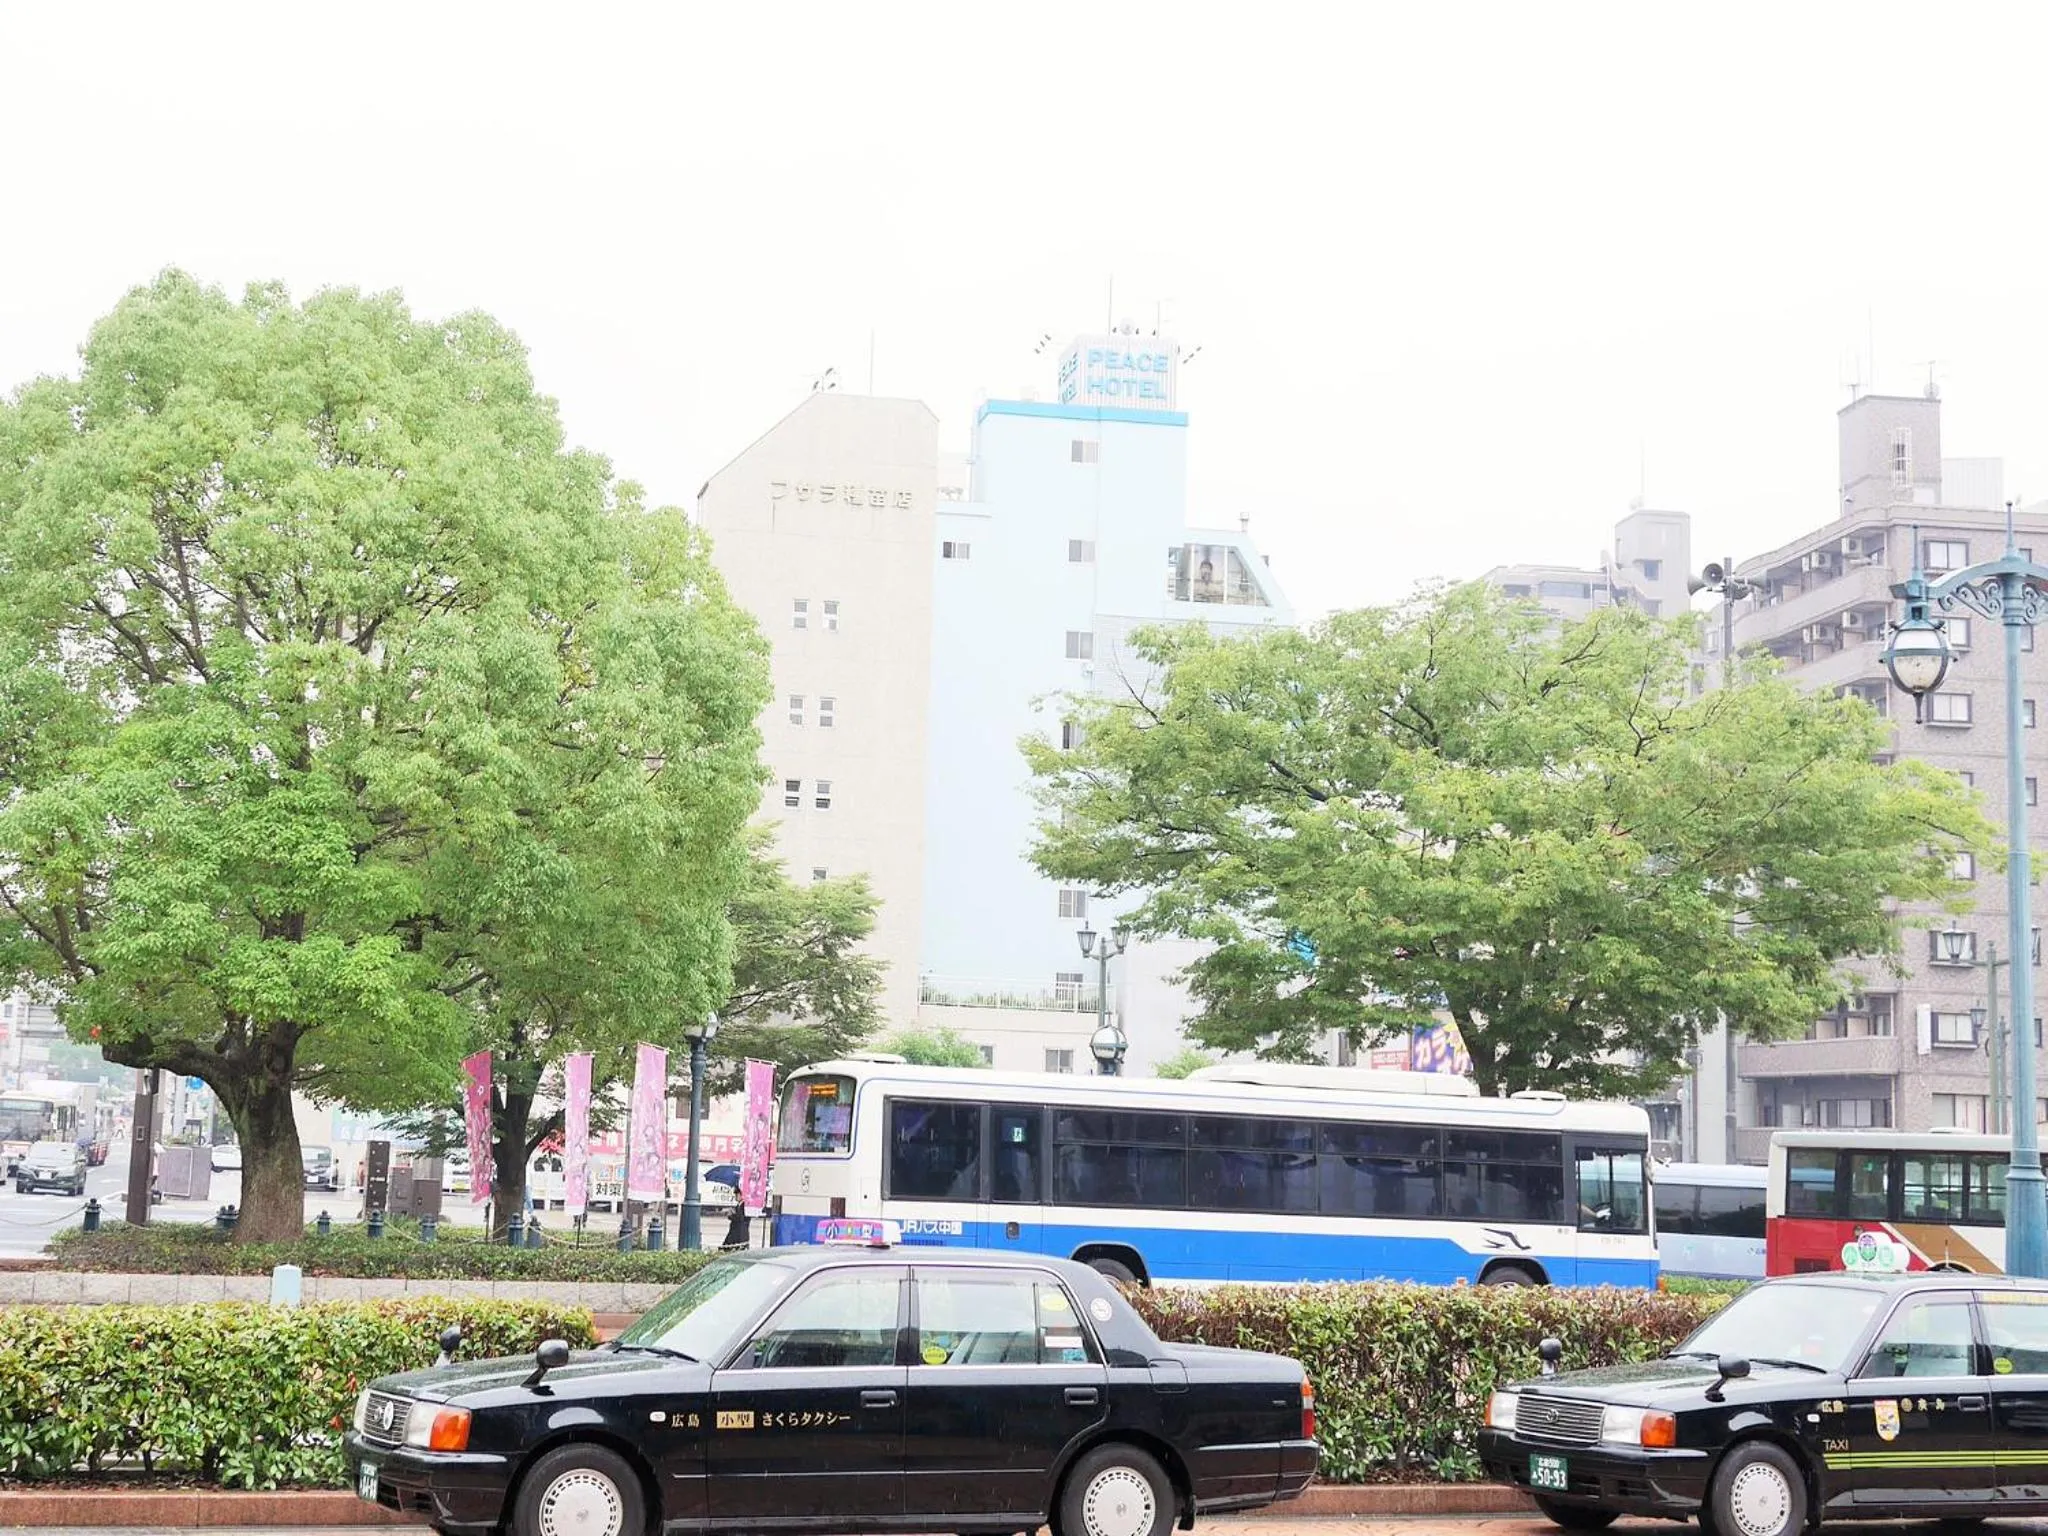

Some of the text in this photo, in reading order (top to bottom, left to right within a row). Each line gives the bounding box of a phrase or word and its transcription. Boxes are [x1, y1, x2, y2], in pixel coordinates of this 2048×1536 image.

[1088, 349, 1168, 372] PEACE
[1088, 377, 1167, 399] HOTEL
[719, 1412, 752, 1428] 小型
[762, 1411, 851, 1427] さくらタクシー
[1823, 1439, 1849, 1451] TAXI
